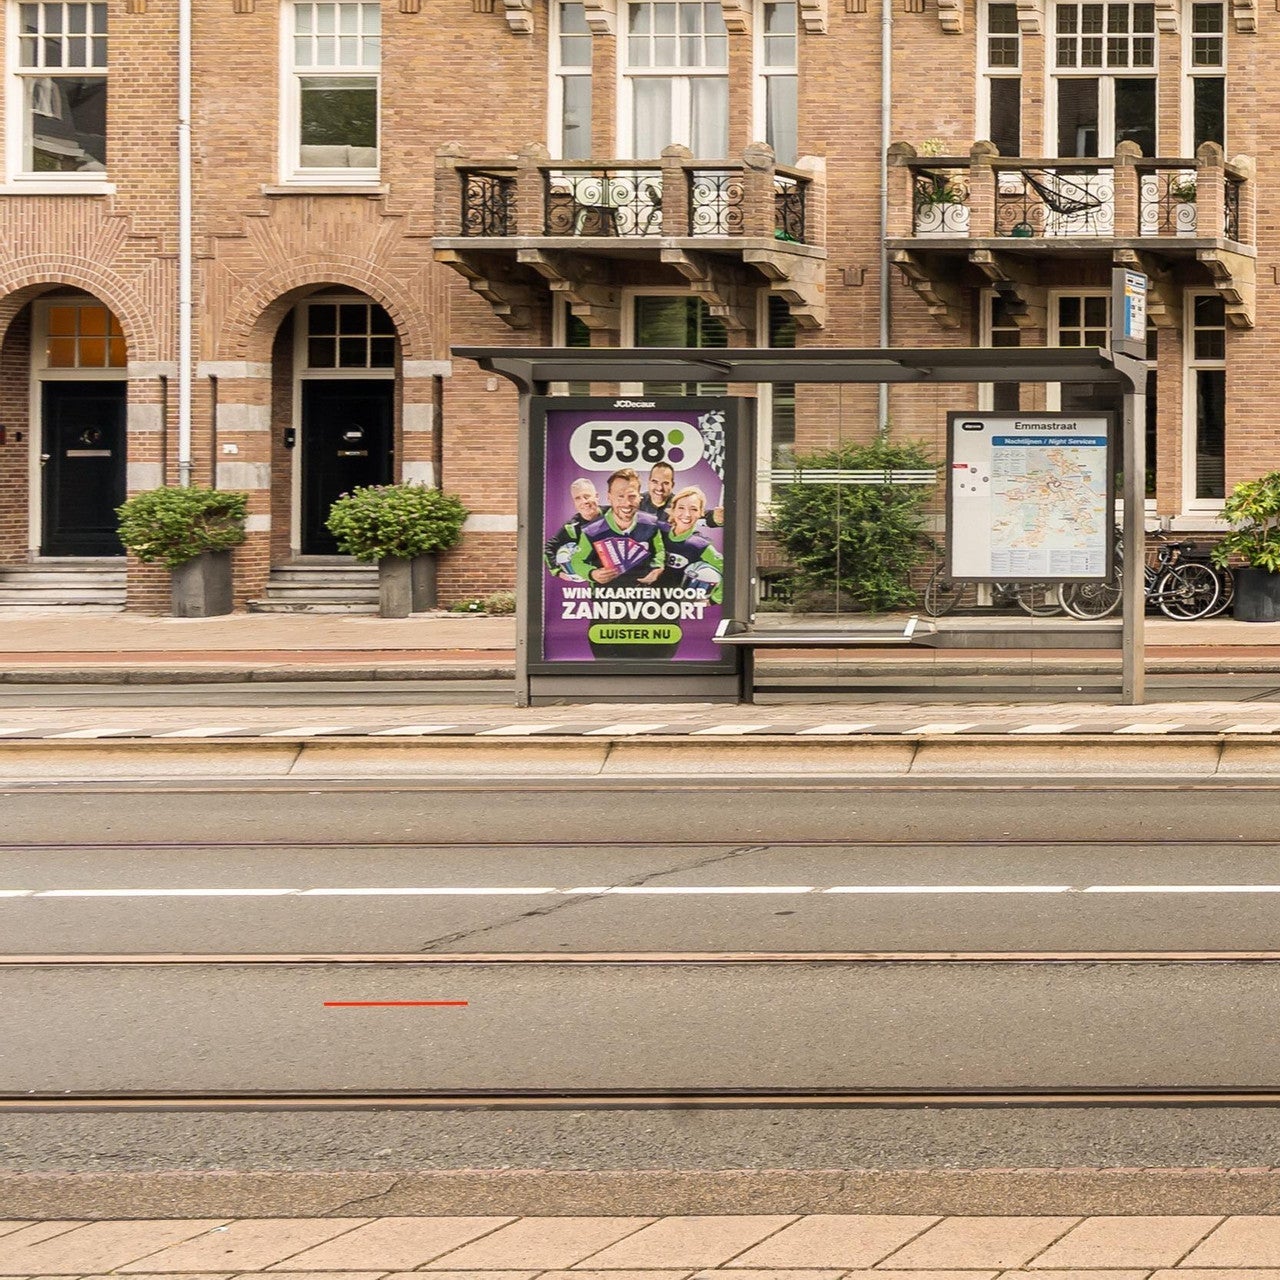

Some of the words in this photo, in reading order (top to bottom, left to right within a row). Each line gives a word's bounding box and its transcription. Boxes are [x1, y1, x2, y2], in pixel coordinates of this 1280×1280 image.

[613, 400, 656, 408] JCDecaux
[1014, 422, 1077, 430] Emmastraat
[589, 429, 665, 463] 538
[562, 587, 591, 599] WIN
[595, 587, 660, 599] KAARTEN
[663, 587, 707, 600] VOOR
[561, 602, 708, 620] ZANDVOORT
[600, 629, 649, 639] LUISTER
[653, 629, 671, 639] NU
